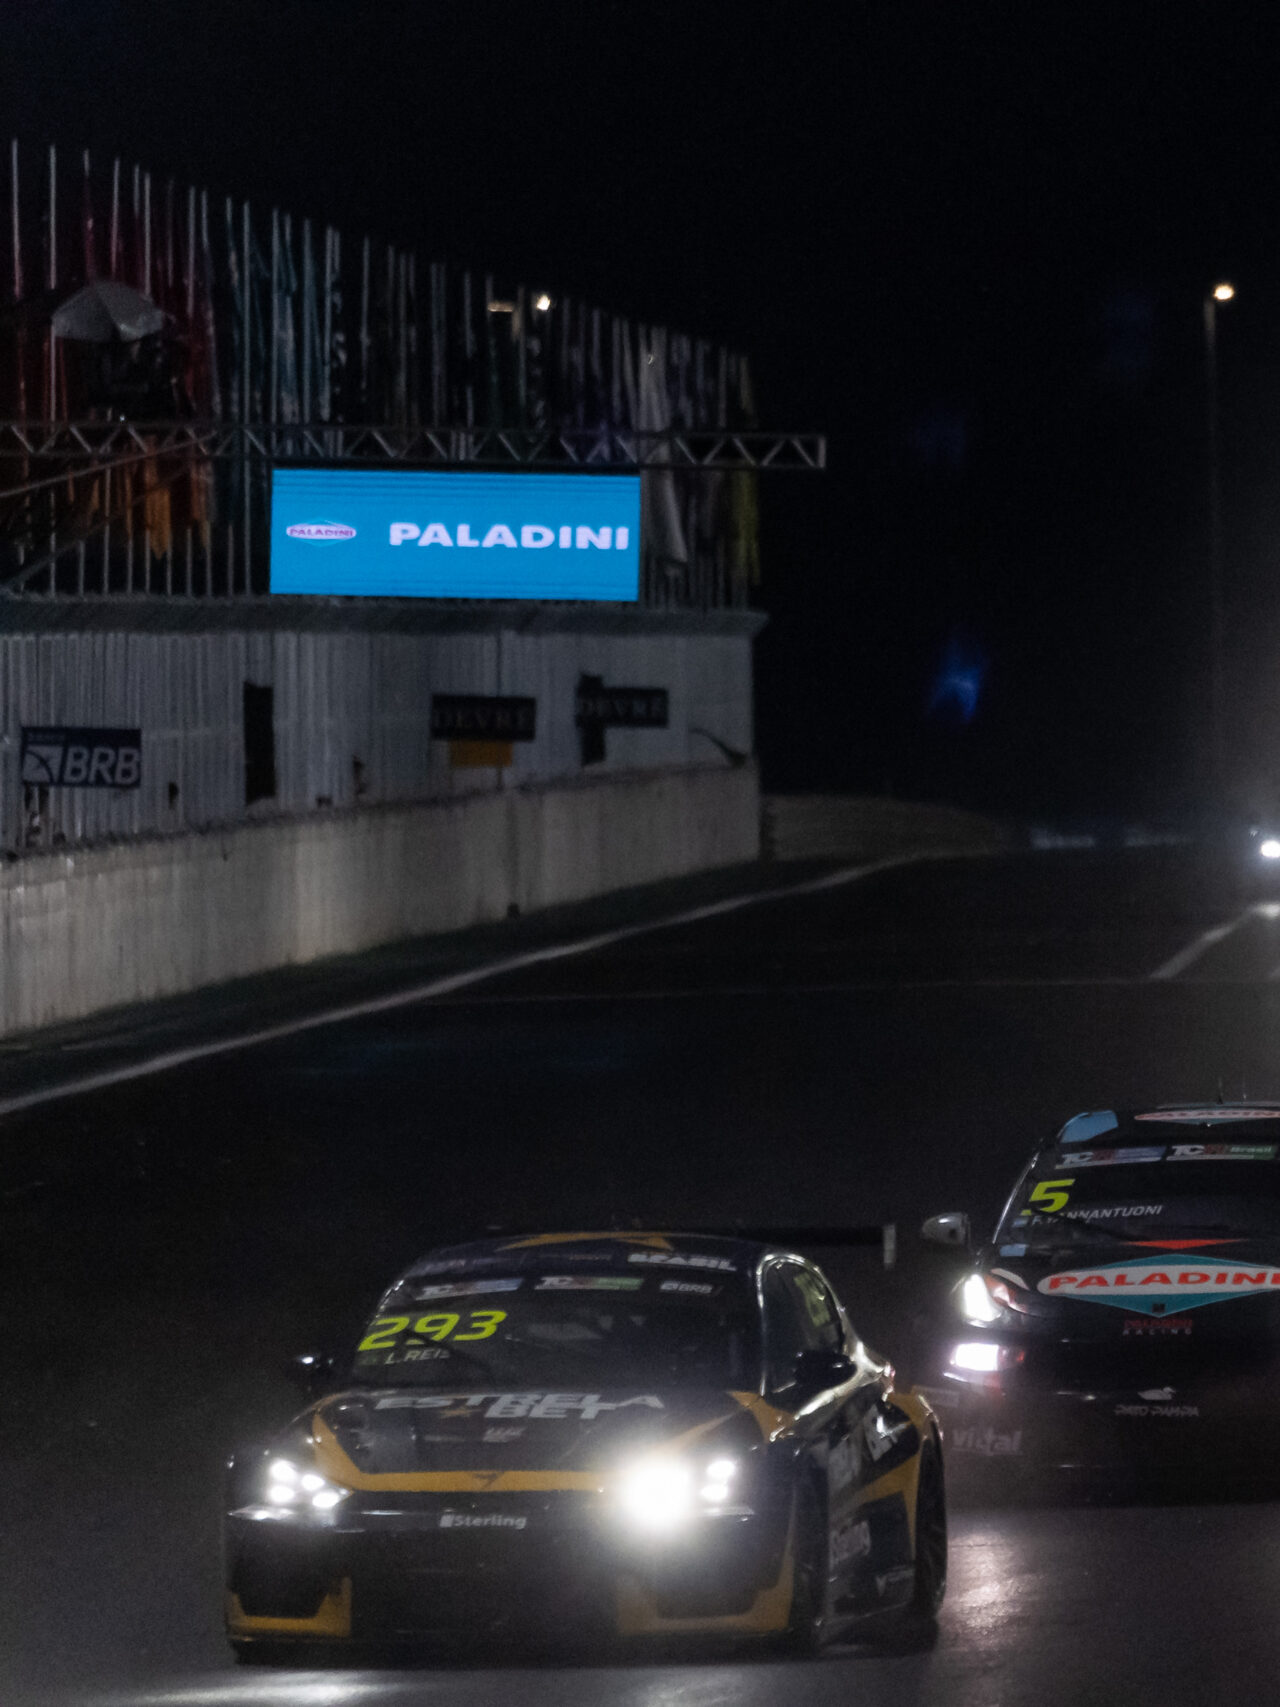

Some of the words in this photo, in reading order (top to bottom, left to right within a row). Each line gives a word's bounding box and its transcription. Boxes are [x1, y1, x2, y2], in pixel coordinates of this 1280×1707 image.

[290, 528, 353, 537] PALADINI
[389, 522, 630, 550] PALADINI
[62, 746, 140, 785] BRB
[1020, 1178, 1076, 1216] 5
[679, 1283, 714, 1294] BRB
[358, 1311, 507, 1351] 293
[484, 1403, 617, 1420] BET
[453, 1514, 527, 1531] Sterling
